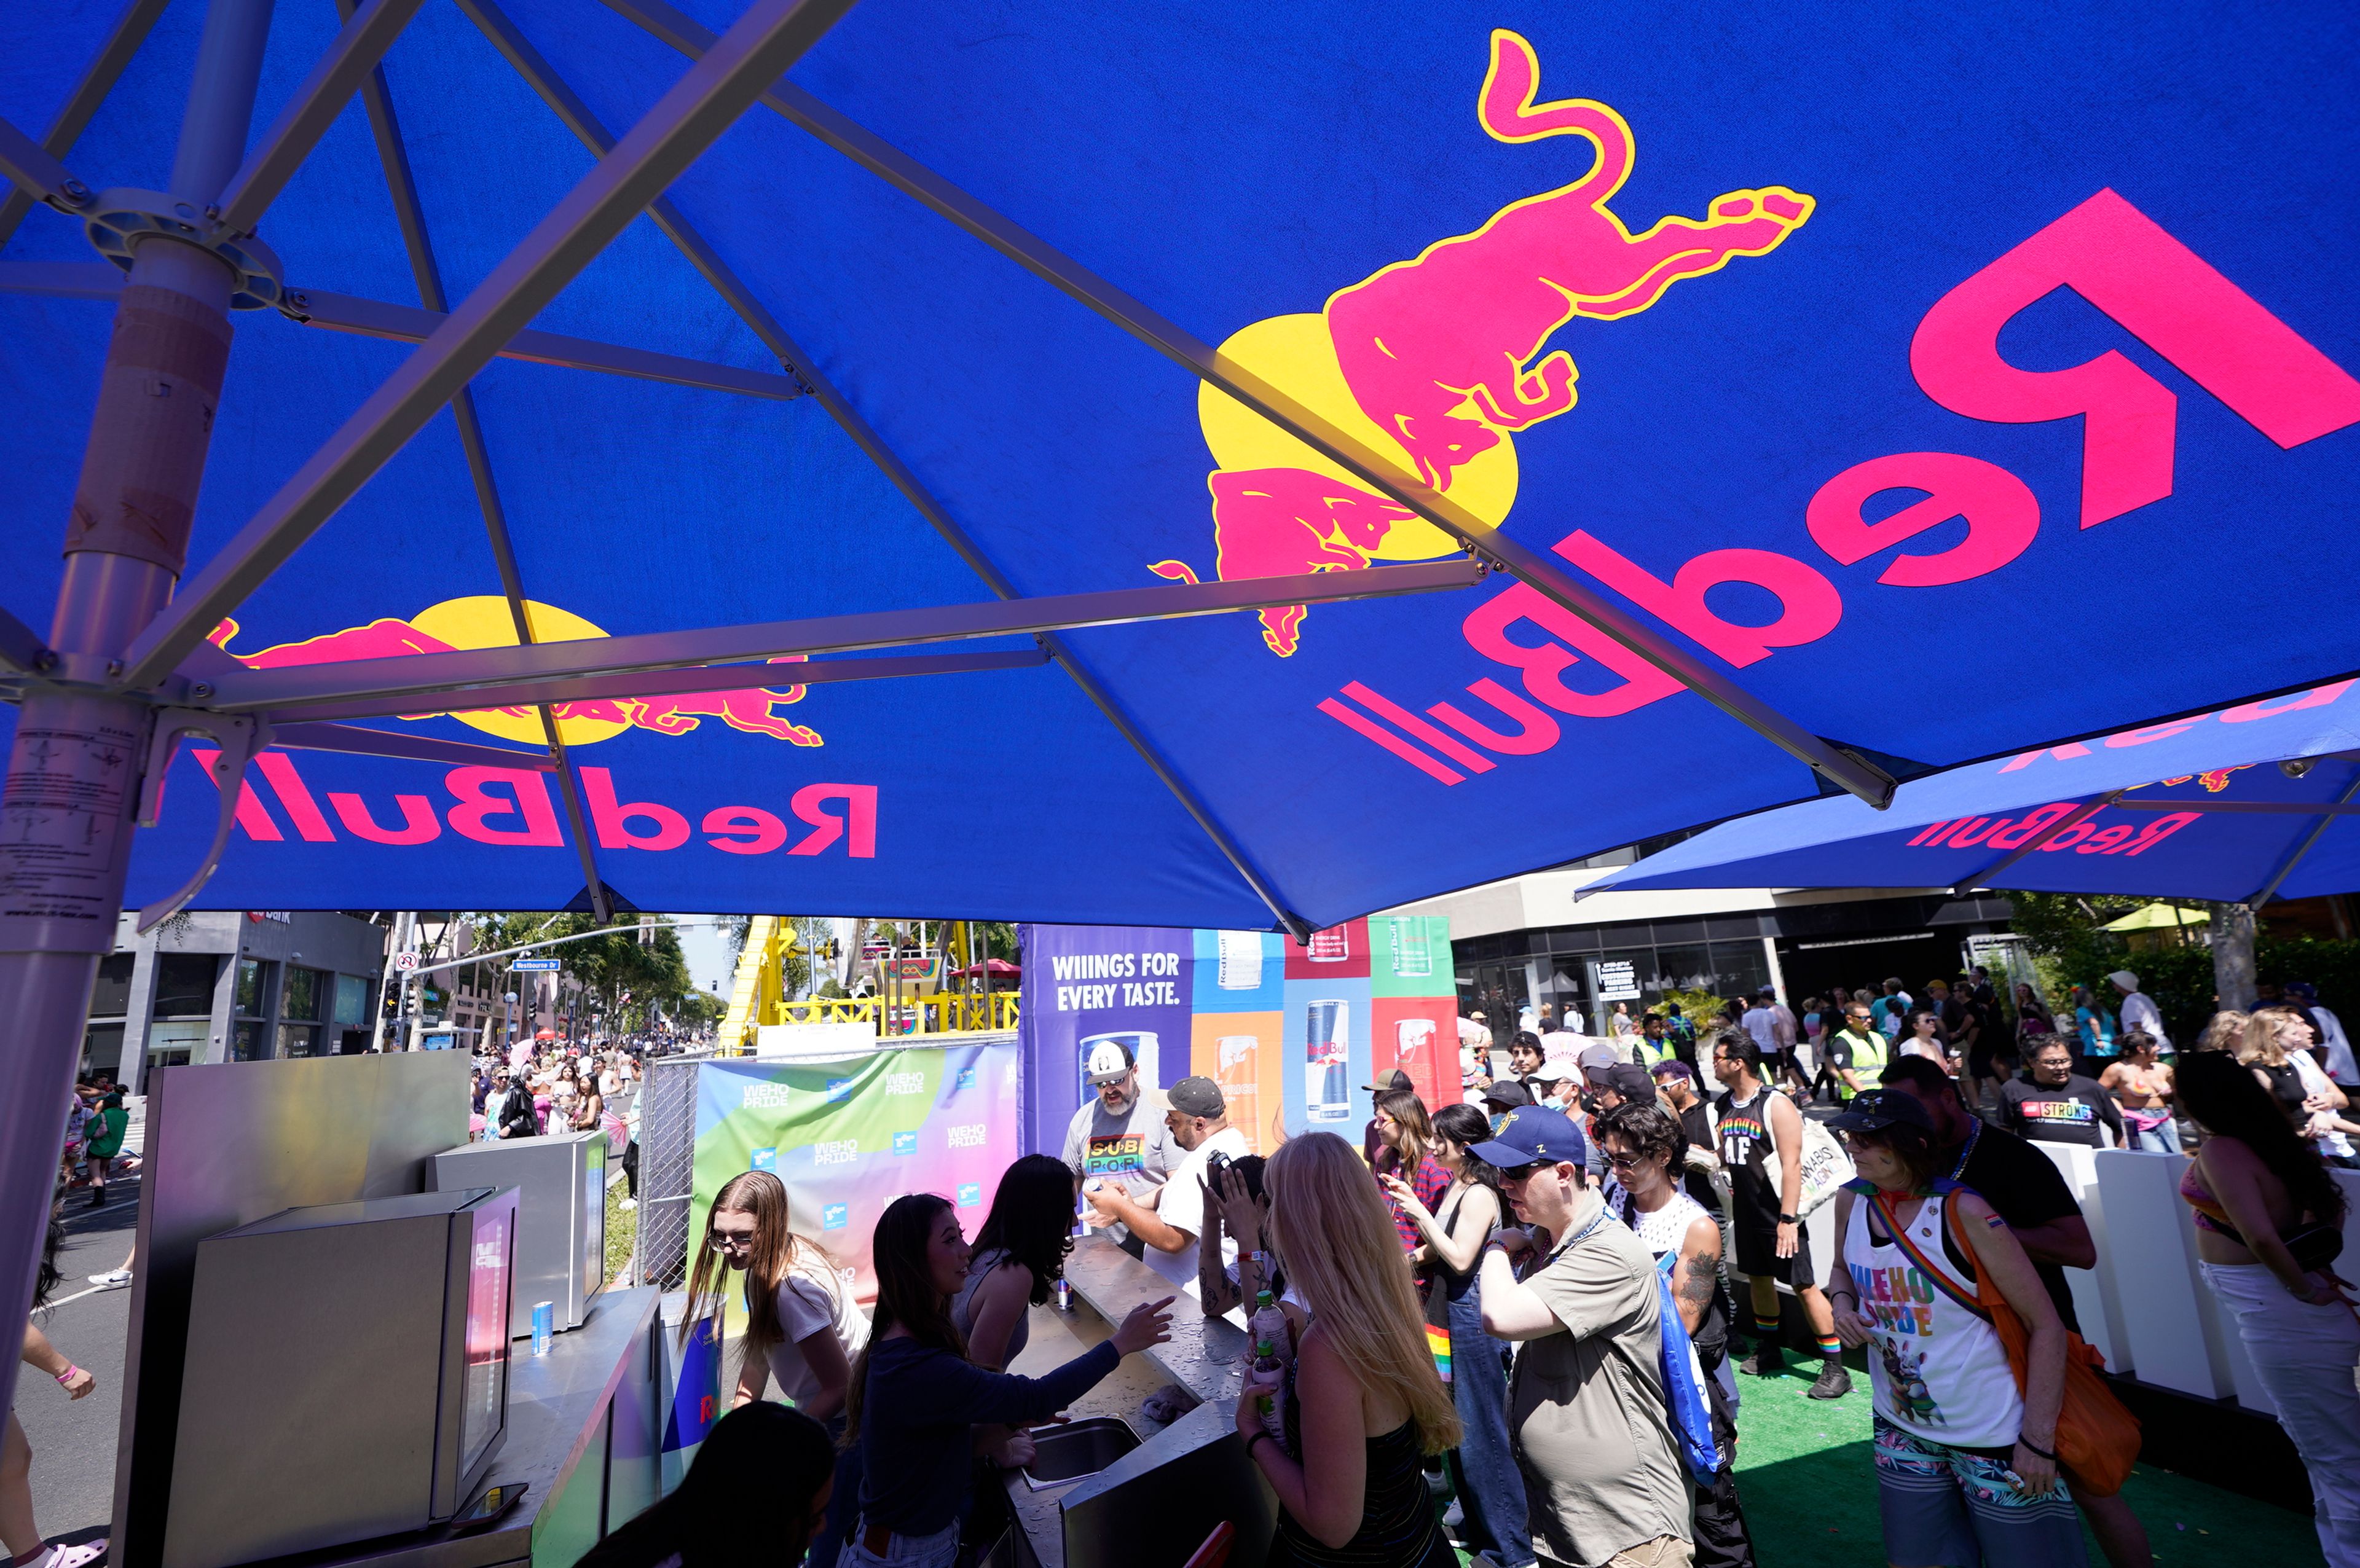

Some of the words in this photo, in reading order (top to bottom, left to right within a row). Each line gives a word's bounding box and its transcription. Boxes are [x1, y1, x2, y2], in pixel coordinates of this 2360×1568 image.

[1052, 953, 1136, 981] WIIINGS
[1141, 952, 1179, 976] FOR
[1058, 983, 1117, 1011] EVERY
[1122, 981, 1180, 1006] TASTE.
[886, 1072, 924, 1085] WEHO
[743, 1084, 789, 1097] WEHO
[885, 1082, 924, 1096] PRIDE
[743, 1095, 788, 1109] PRIDE
[947, 1124, 986, 1138] WEHO
[814, 1139, 858, 1155] WEHO
[948, 1134, 986, 1148] PRIDE
[814, 1150, 857, 1166] PRIDE
[1725, 1136, 1751, 1165] AF
[1850, 1263, 1935, 1304] WEHO
